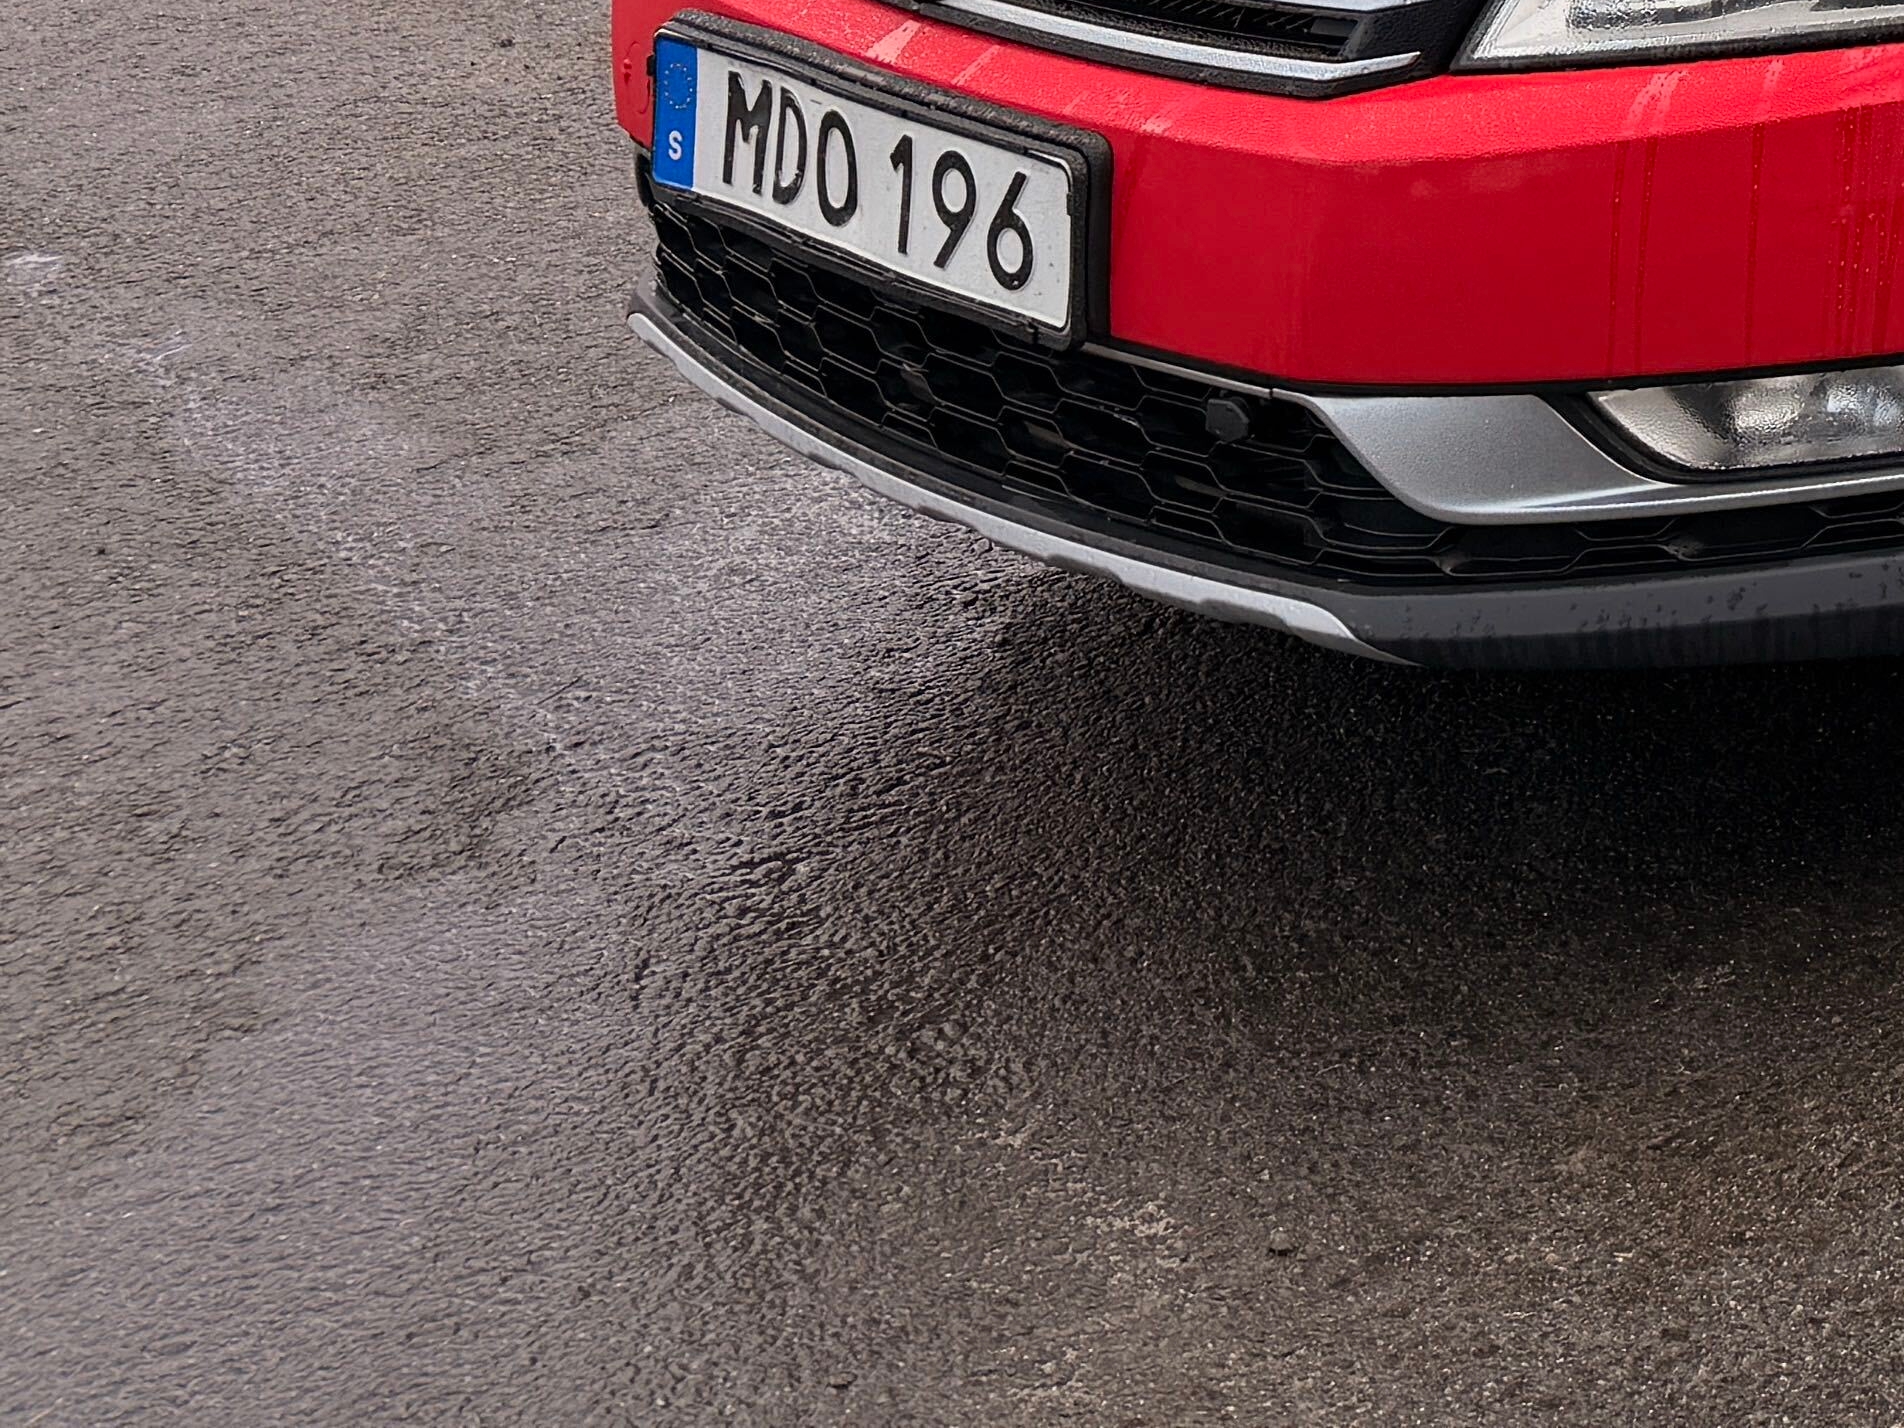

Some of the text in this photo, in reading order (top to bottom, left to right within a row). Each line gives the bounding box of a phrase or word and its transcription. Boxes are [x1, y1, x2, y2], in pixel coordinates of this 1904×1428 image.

[667, 129, 684, 162] S
[721, 69, 1034, 292] MDO 196
